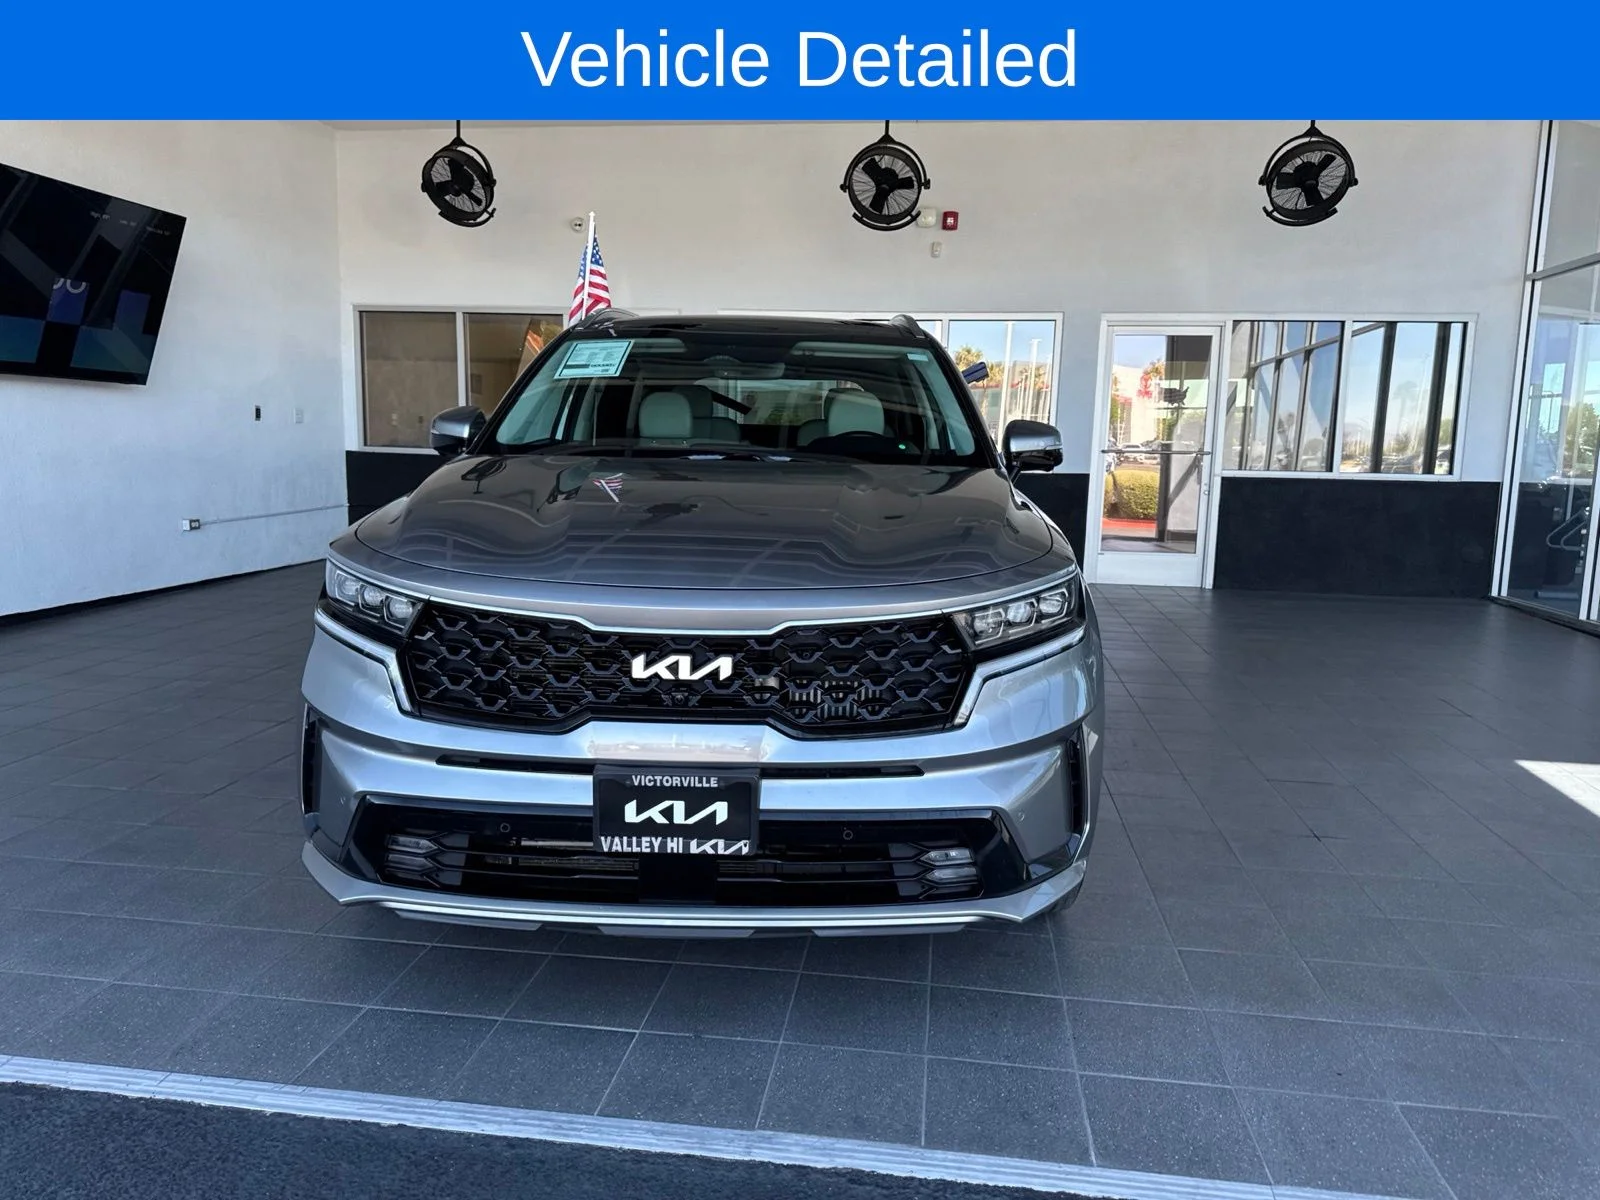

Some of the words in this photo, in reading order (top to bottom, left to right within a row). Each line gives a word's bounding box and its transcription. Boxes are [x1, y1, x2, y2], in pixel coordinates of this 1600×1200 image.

[631, 654, 734, 681] KIA
[632, 775, 719, 788] VICTORVILLE
[624, 800, 728, 826] KIA
[600, 836, 662, 853] VALLEY
[667, 838, 684, 854] HI
